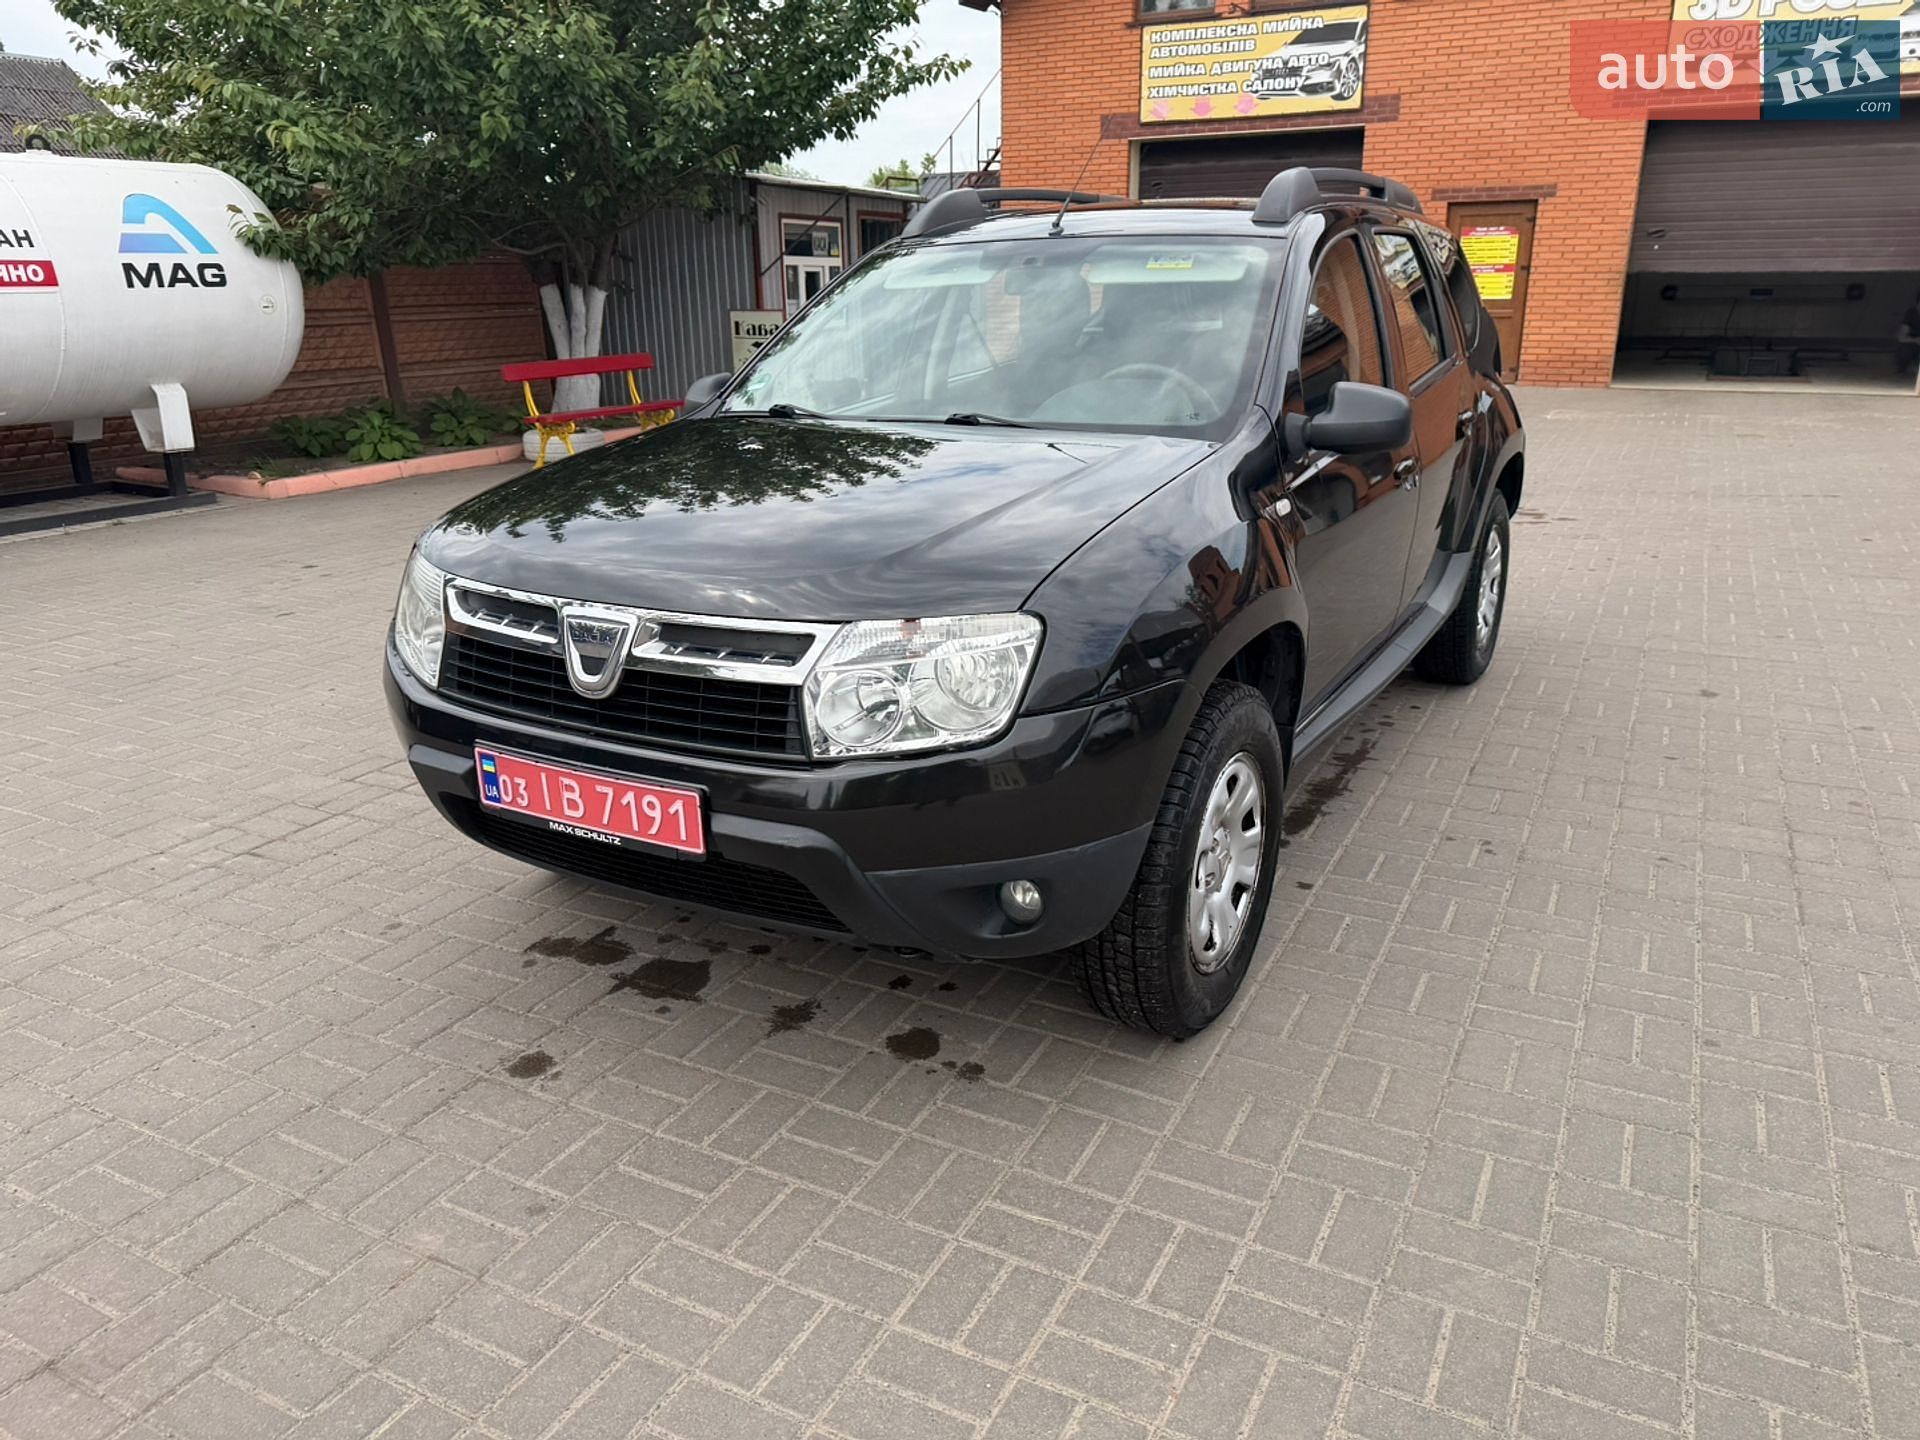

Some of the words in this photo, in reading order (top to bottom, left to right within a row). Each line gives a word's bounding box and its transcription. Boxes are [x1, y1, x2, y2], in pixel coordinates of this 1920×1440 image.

[1151, 23, 1258, 43] КОМПЛЕКСНА
[1262, 16, 1324, 33] МИЙКА
[1685, 16, 1858, 49] СХОДЖЕННЯ
[1149, 39, 1256, 59] АВТОМОБІЛІВ
[1149, 62, 1206, 79] МИЙКА
[1210, 57, 1284, 76] ДВИГУНА
[1287, 53, 1330, 68] АВТО
[1148, 81, 1238, 99] ХІМЧИСТКА
[1242, 75, 1305, 93] САЛОНУ
[122, 262, 227, 289] MAG
[485, 784, 499, 799] UA
[499, 774, 528, 807] 03
[595, 785, 687, 842] 7191
[549, 821, 573, 835] MAX
[574, 828, 622, 845] SCHULTZ
